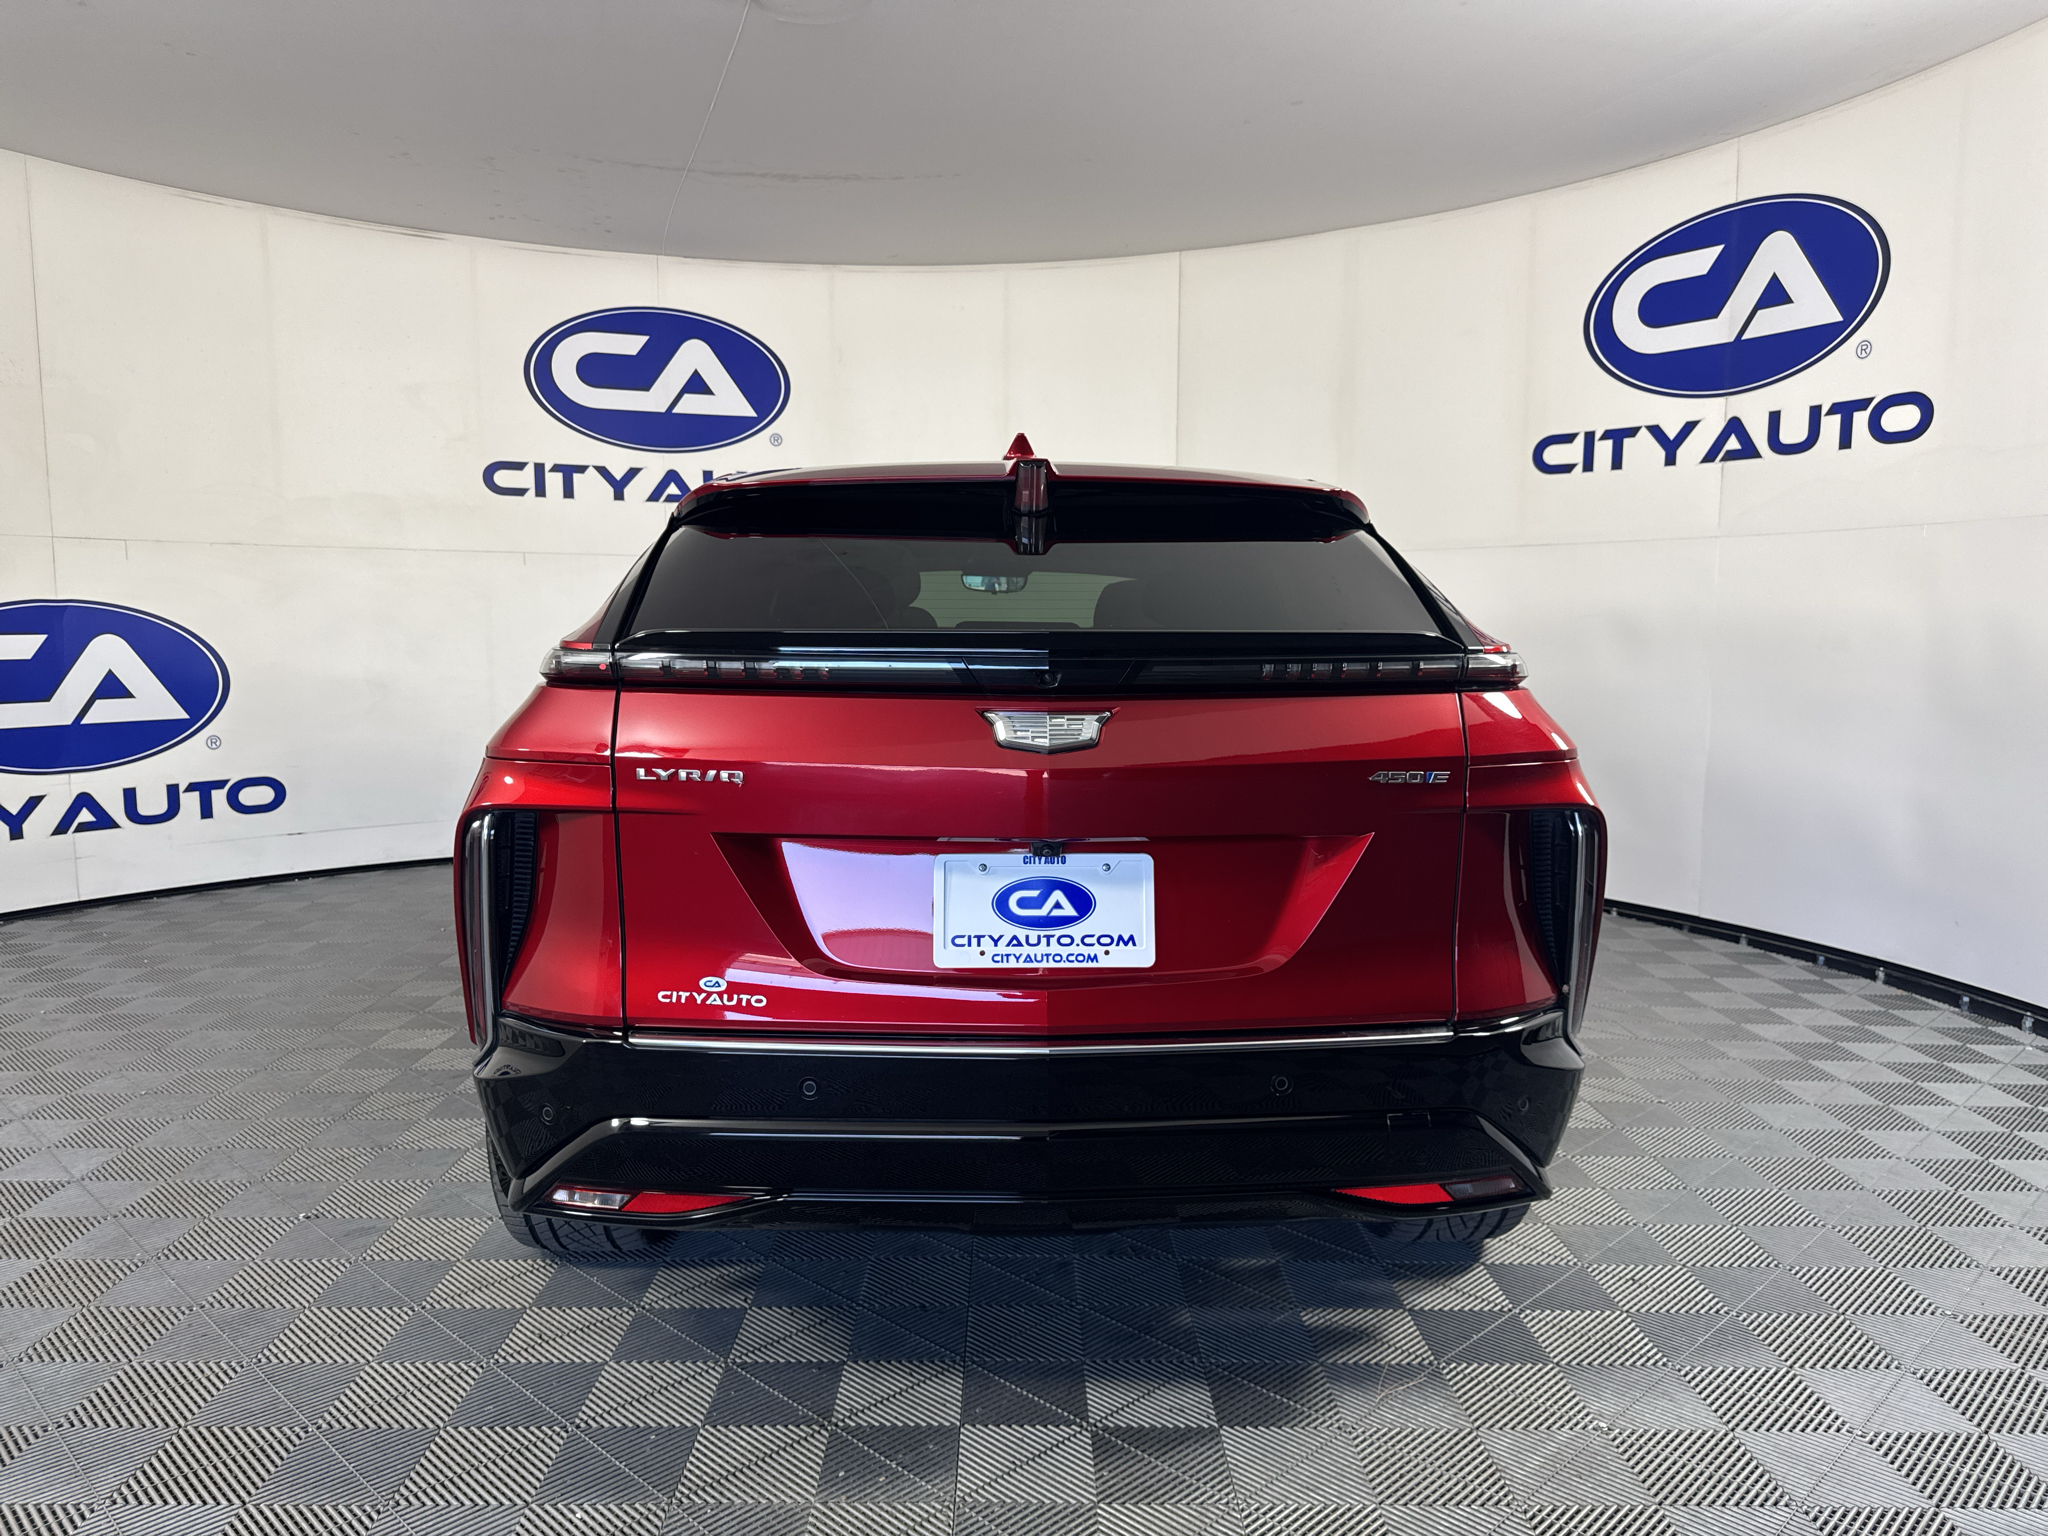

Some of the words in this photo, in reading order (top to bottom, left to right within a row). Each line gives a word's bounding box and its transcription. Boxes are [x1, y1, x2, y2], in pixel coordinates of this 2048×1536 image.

[1611, 229, 1845, 355] CA
[551, 331, 759, 418] CA
[482, 460, 748, 503] CITYA
[636, 767, 745, 788] LYRIQ
[1008, 889, 1080, 917] CA
[951, 933, 1137, 948] CITYAUTO.COM
[991, 953, 1099, 964] CITYAUTO.COM
[703, 980, 722, 988] CA
[657, 991, 767, 1007] CITYAUTO
